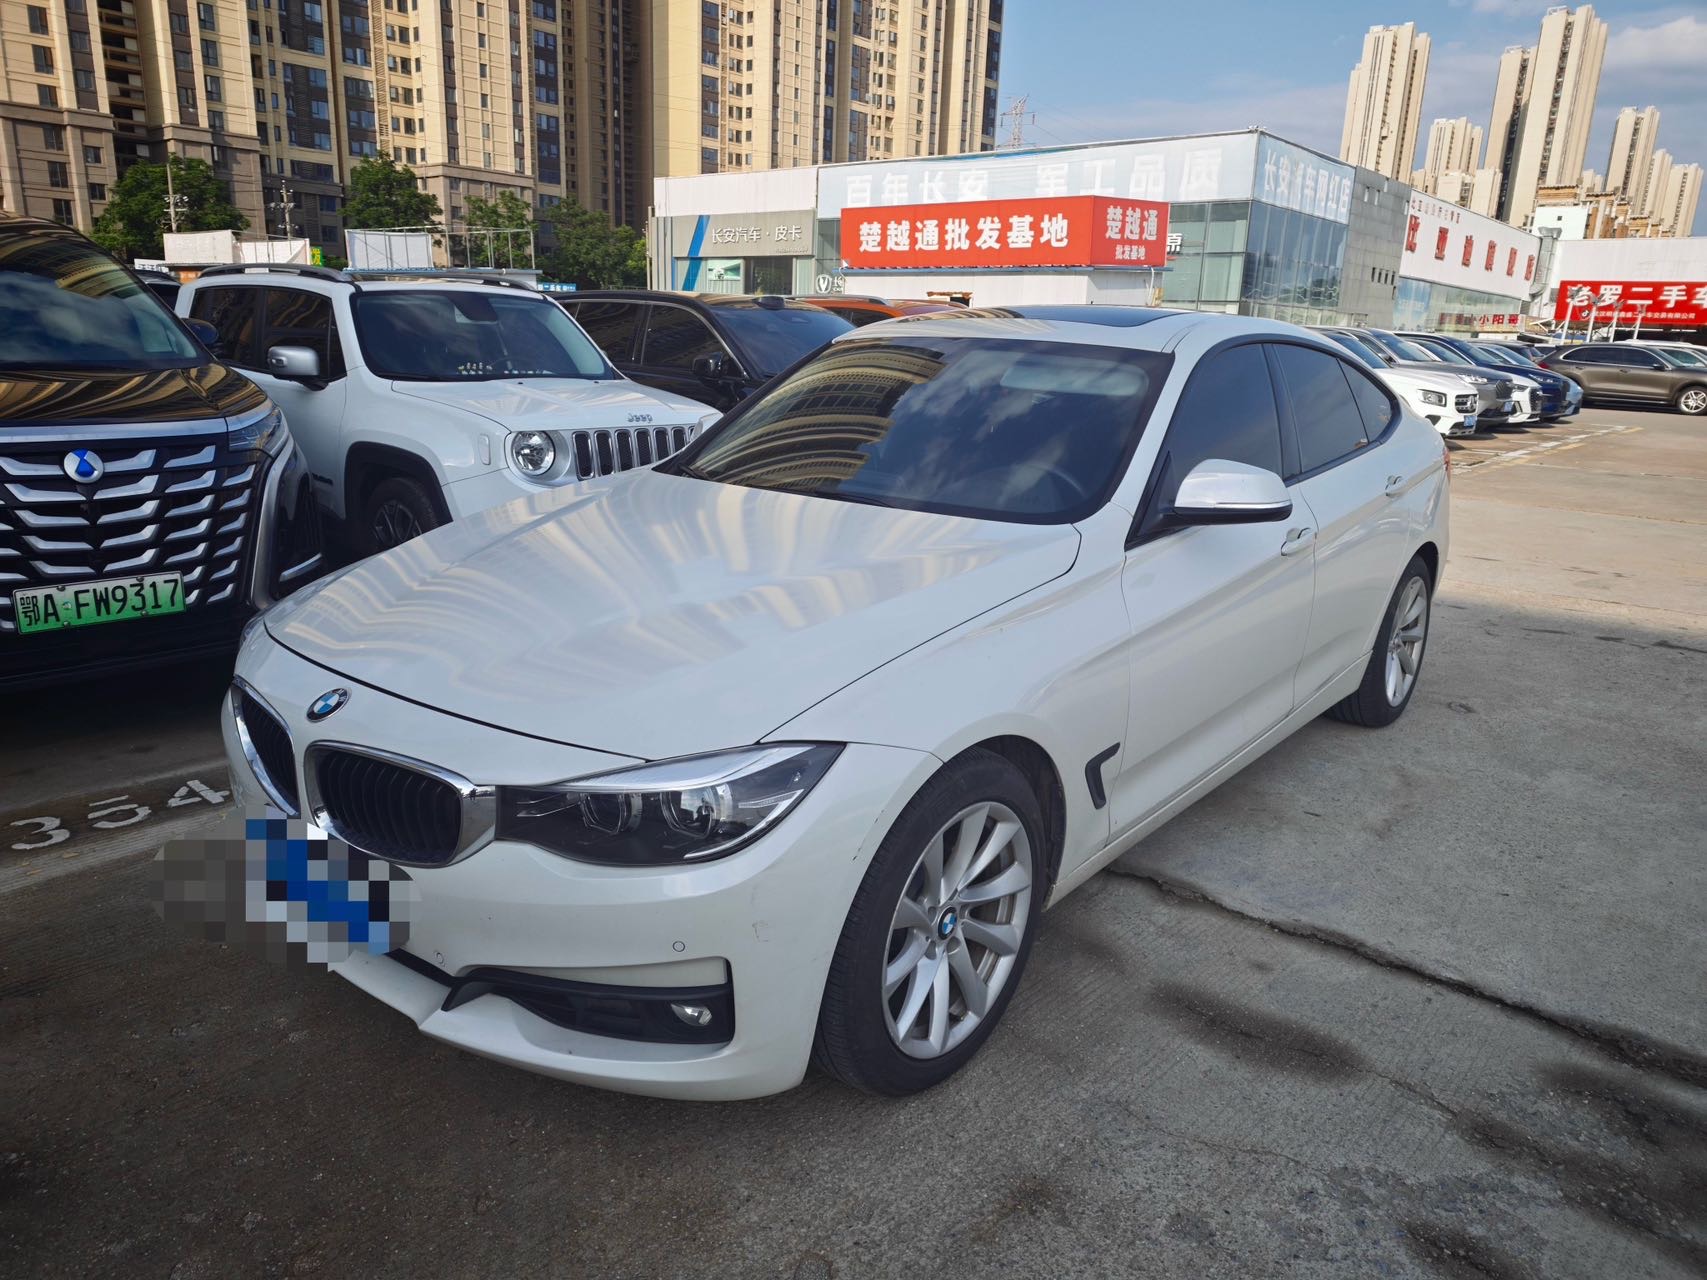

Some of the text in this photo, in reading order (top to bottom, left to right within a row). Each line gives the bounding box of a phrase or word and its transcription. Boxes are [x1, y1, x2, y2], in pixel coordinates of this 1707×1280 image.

[846, 148, 1222, 205] 百年长安 军工品质
[859, 213, 1068, 252] 楚越通批发基地
[1105, 205, 1158, 240] 楚越通
[1115, 244, 1145, 260] 批发基地
[10, 780, 230, 850] 354
